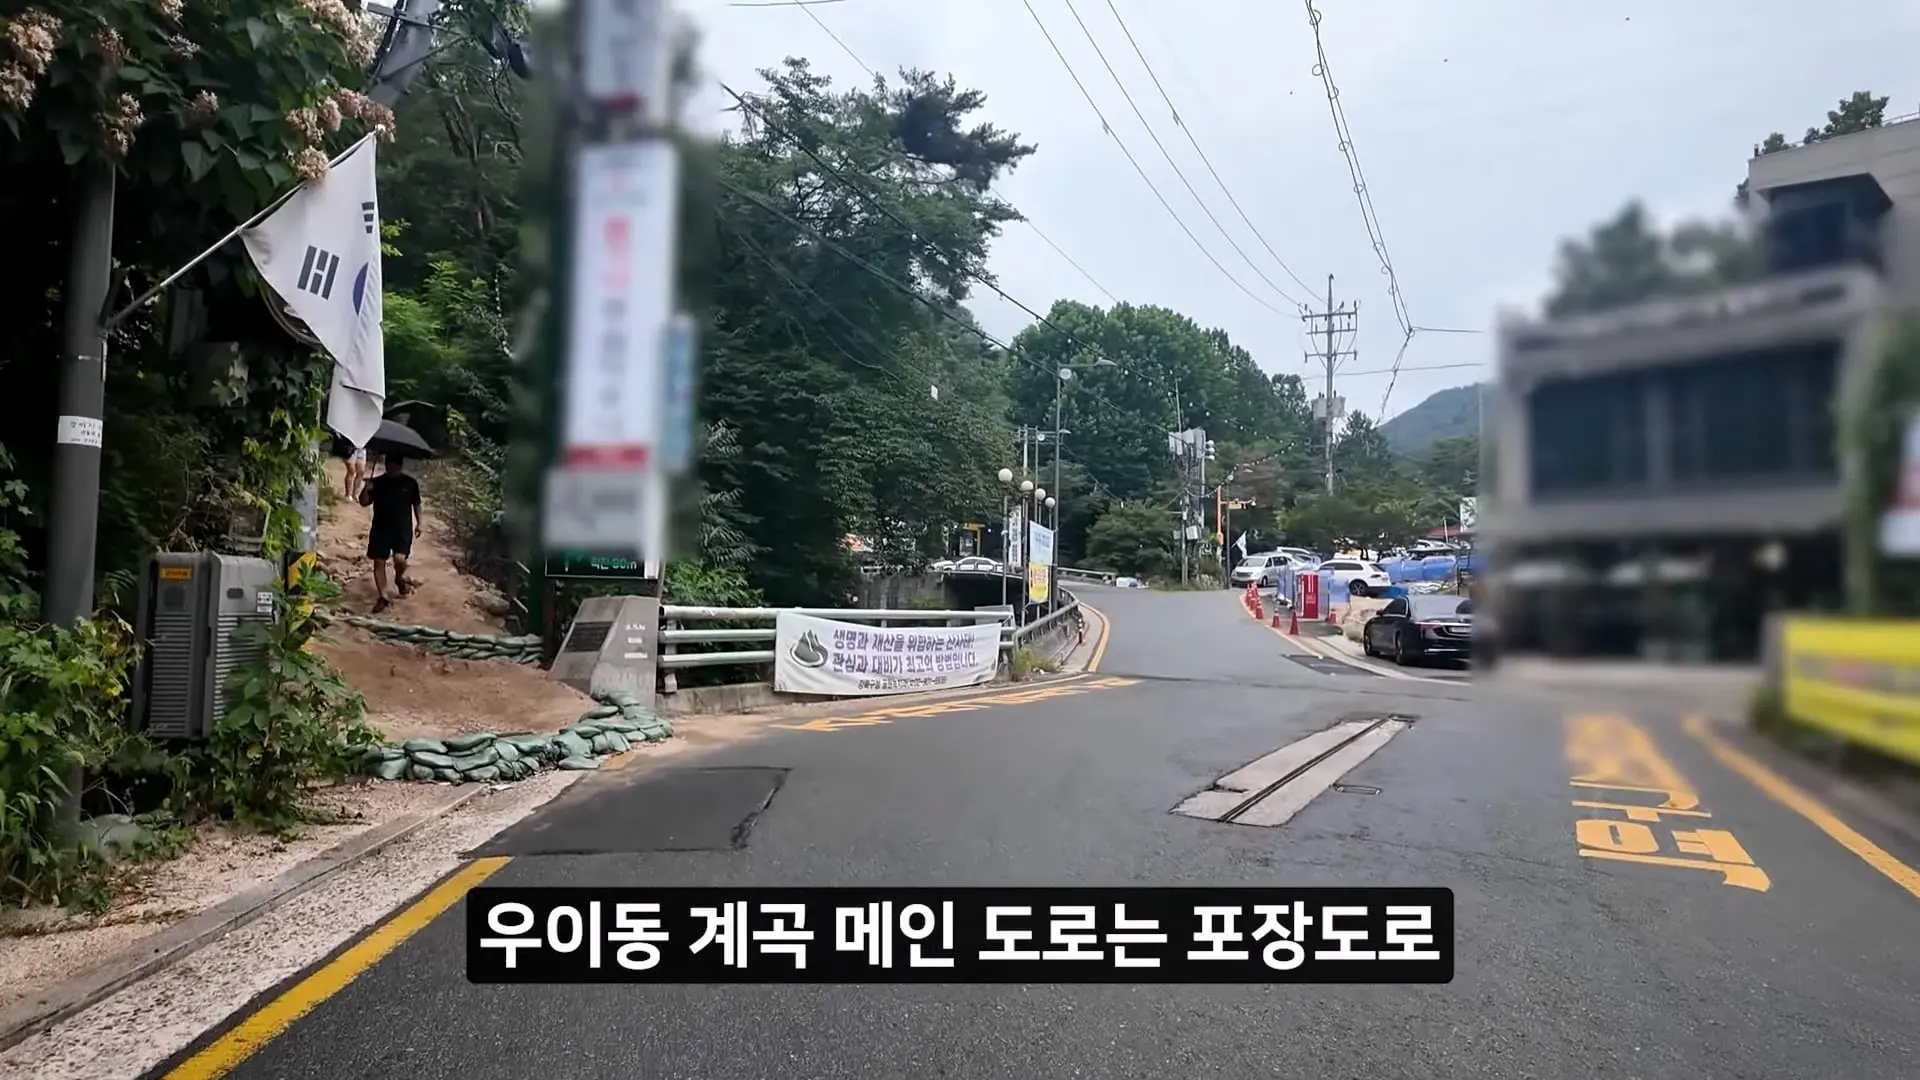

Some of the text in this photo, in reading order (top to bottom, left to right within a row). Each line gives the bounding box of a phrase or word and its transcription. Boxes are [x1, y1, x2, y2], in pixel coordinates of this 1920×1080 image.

[833, 629, 869, 649] 생명과
[872, 633, 905, 653] 재산을
[832, 652, 869, 674] 관심과
[872, 654, 903, 675] 대비가
[906, 654, 934, 674] 최고의
